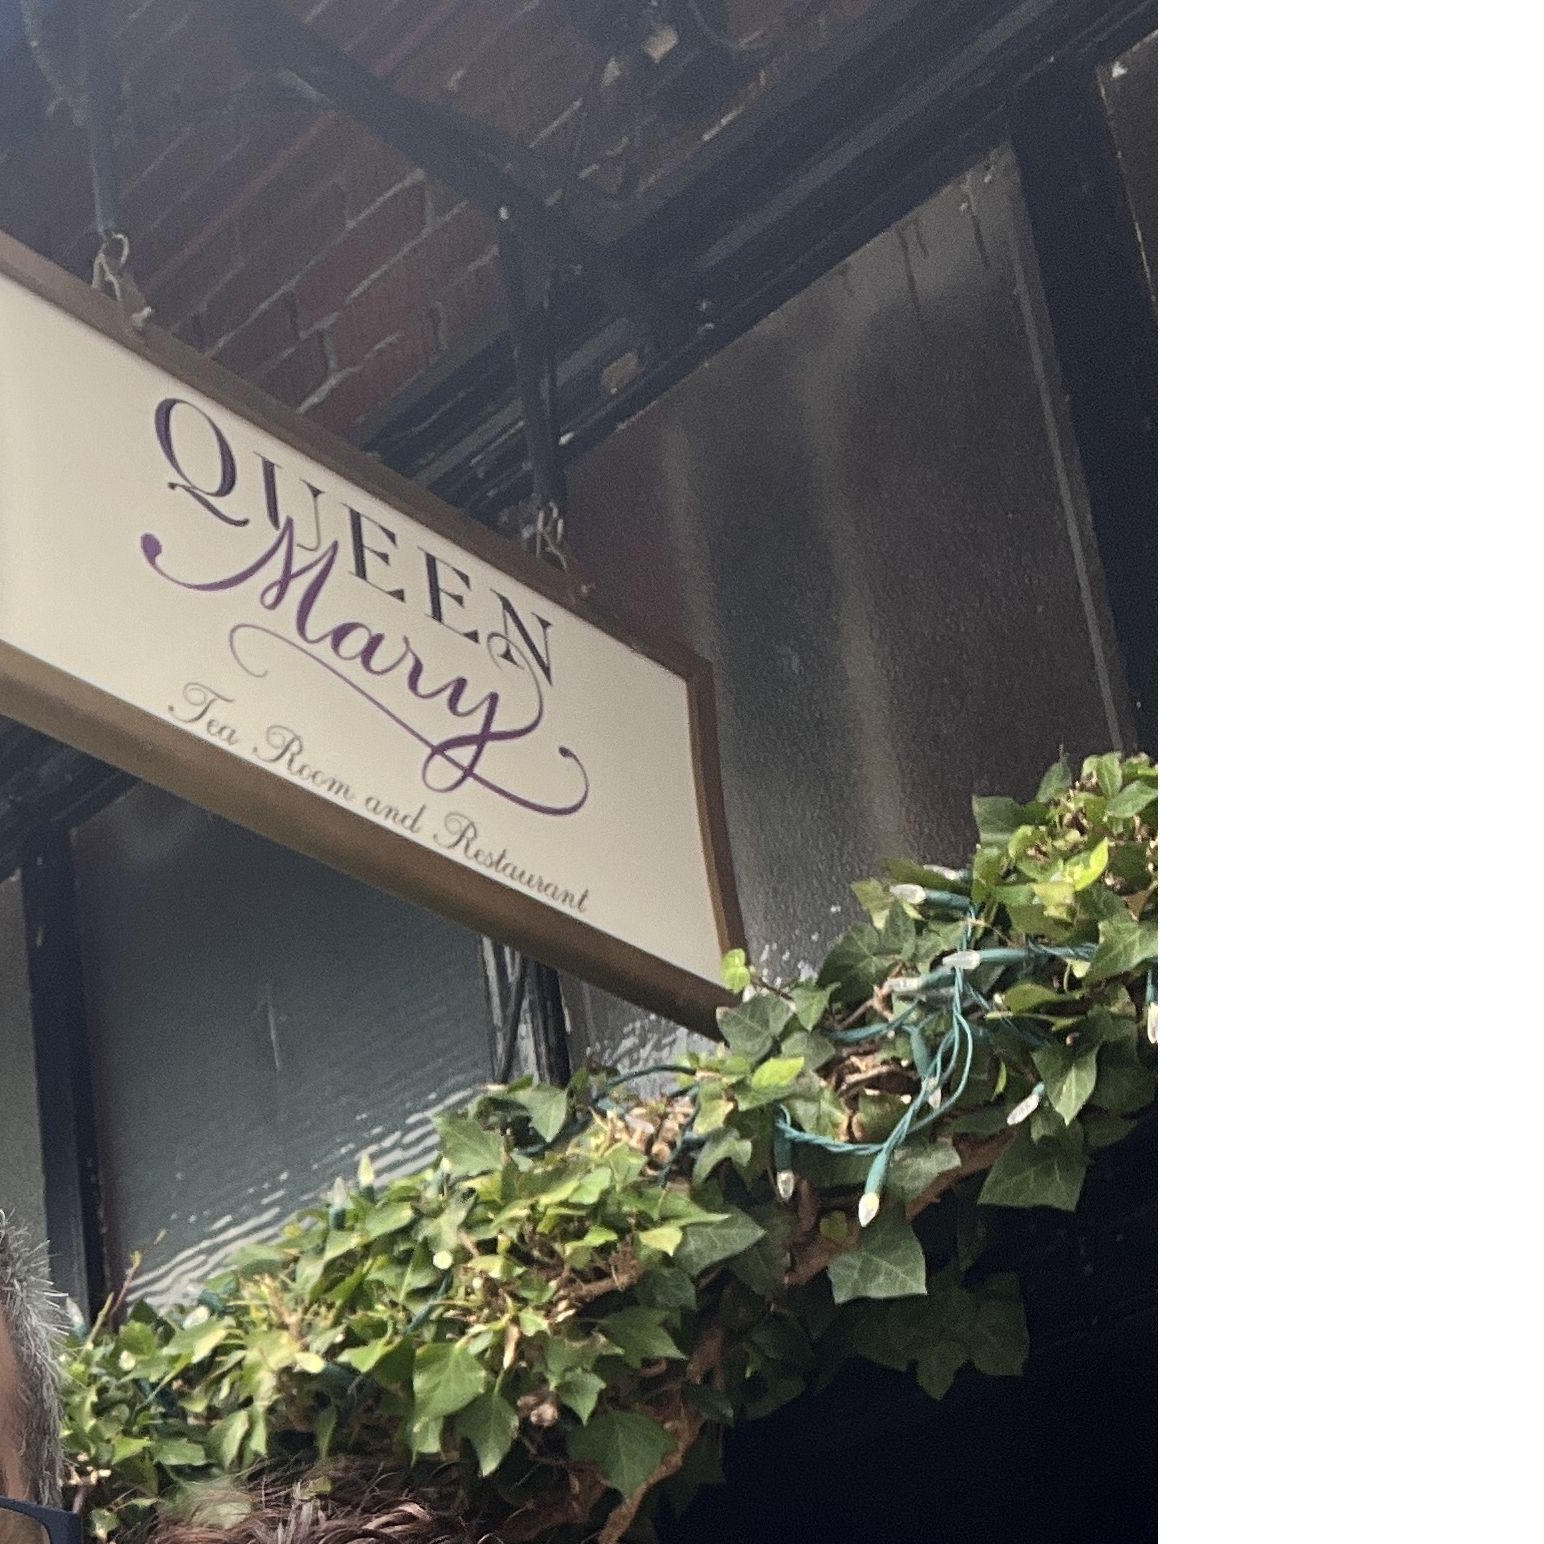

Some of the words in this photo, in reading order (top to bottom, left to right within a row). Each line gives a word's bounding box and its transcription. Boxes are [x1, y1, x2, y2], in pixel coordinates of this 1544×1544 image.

[140, 515, 589, 816] Mary
[155, 398, 553, 687] QUEEN
[168, 682, 239, 746] Tea
[252, 725, 354, 804] Room
[364, 794, 426, 834] and
[433, 811, 590, 913] Restaurant
